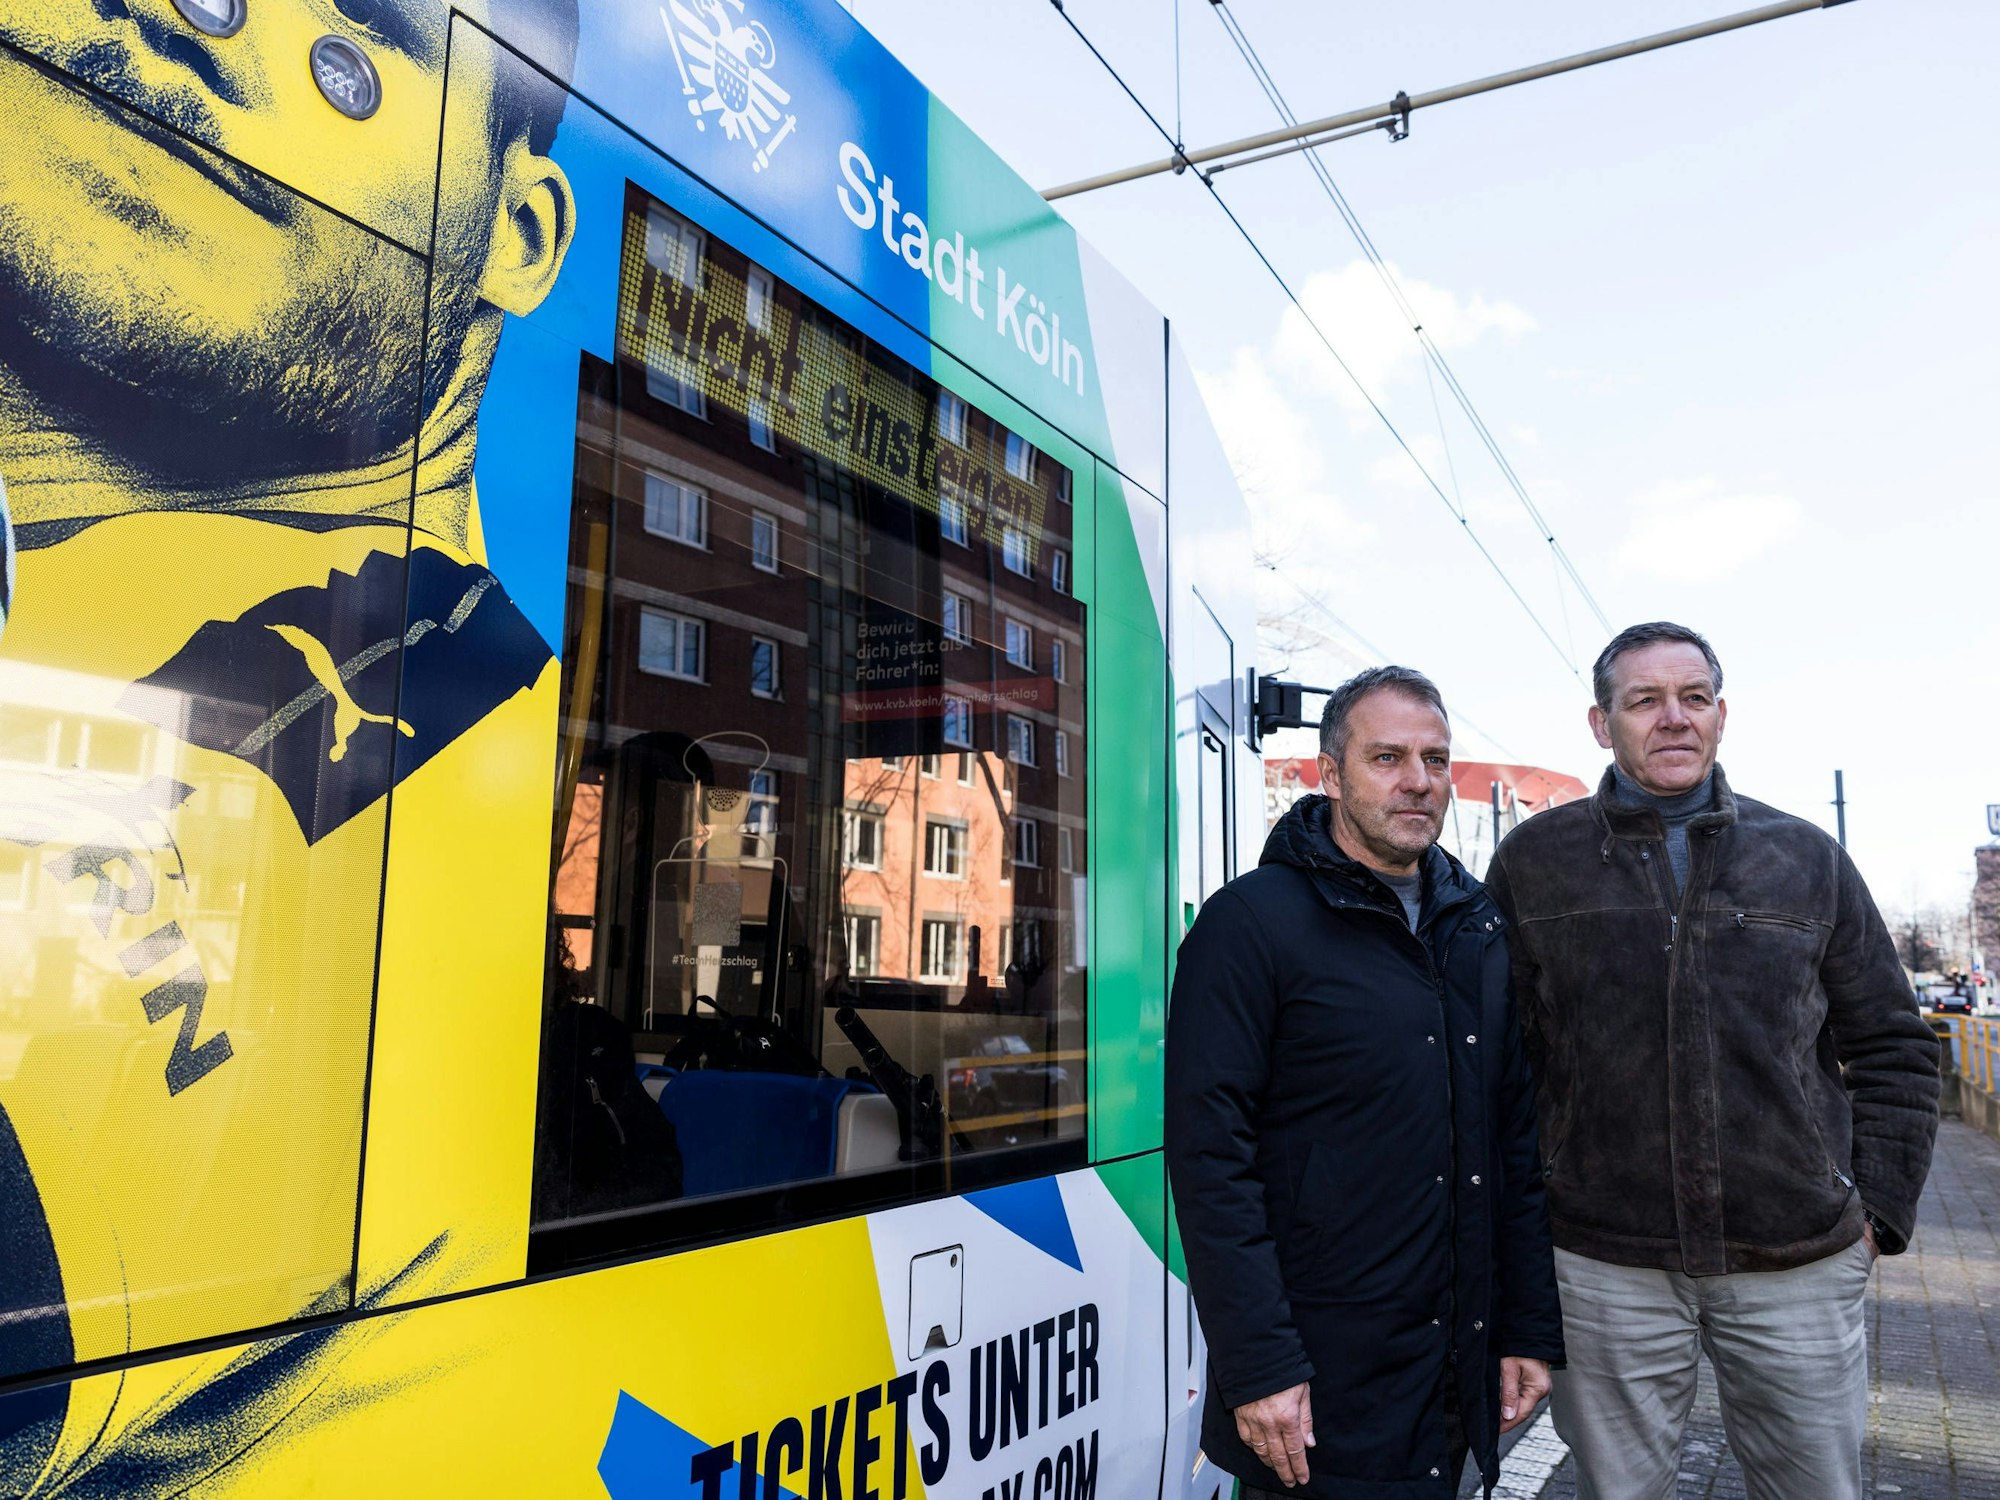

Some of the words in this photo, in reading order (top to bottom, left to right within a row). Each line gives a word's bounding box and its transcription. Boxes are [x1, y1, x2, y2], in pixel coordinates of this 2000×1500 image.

[836, 141, 985, 321] Stadt
[997, 266, 1084, 398] Köln
[634, 222, 801, 417] Nicht
[822, 374, 1032, 543] einsteigen
[856, 641, 890, 660] dich
[893, 637, 935, 660] jetzt
[939, 638, 964, 652] als
[857, 617, 916, 638] Bewirb
[968, 1302, 1100, 1462] UNTER
